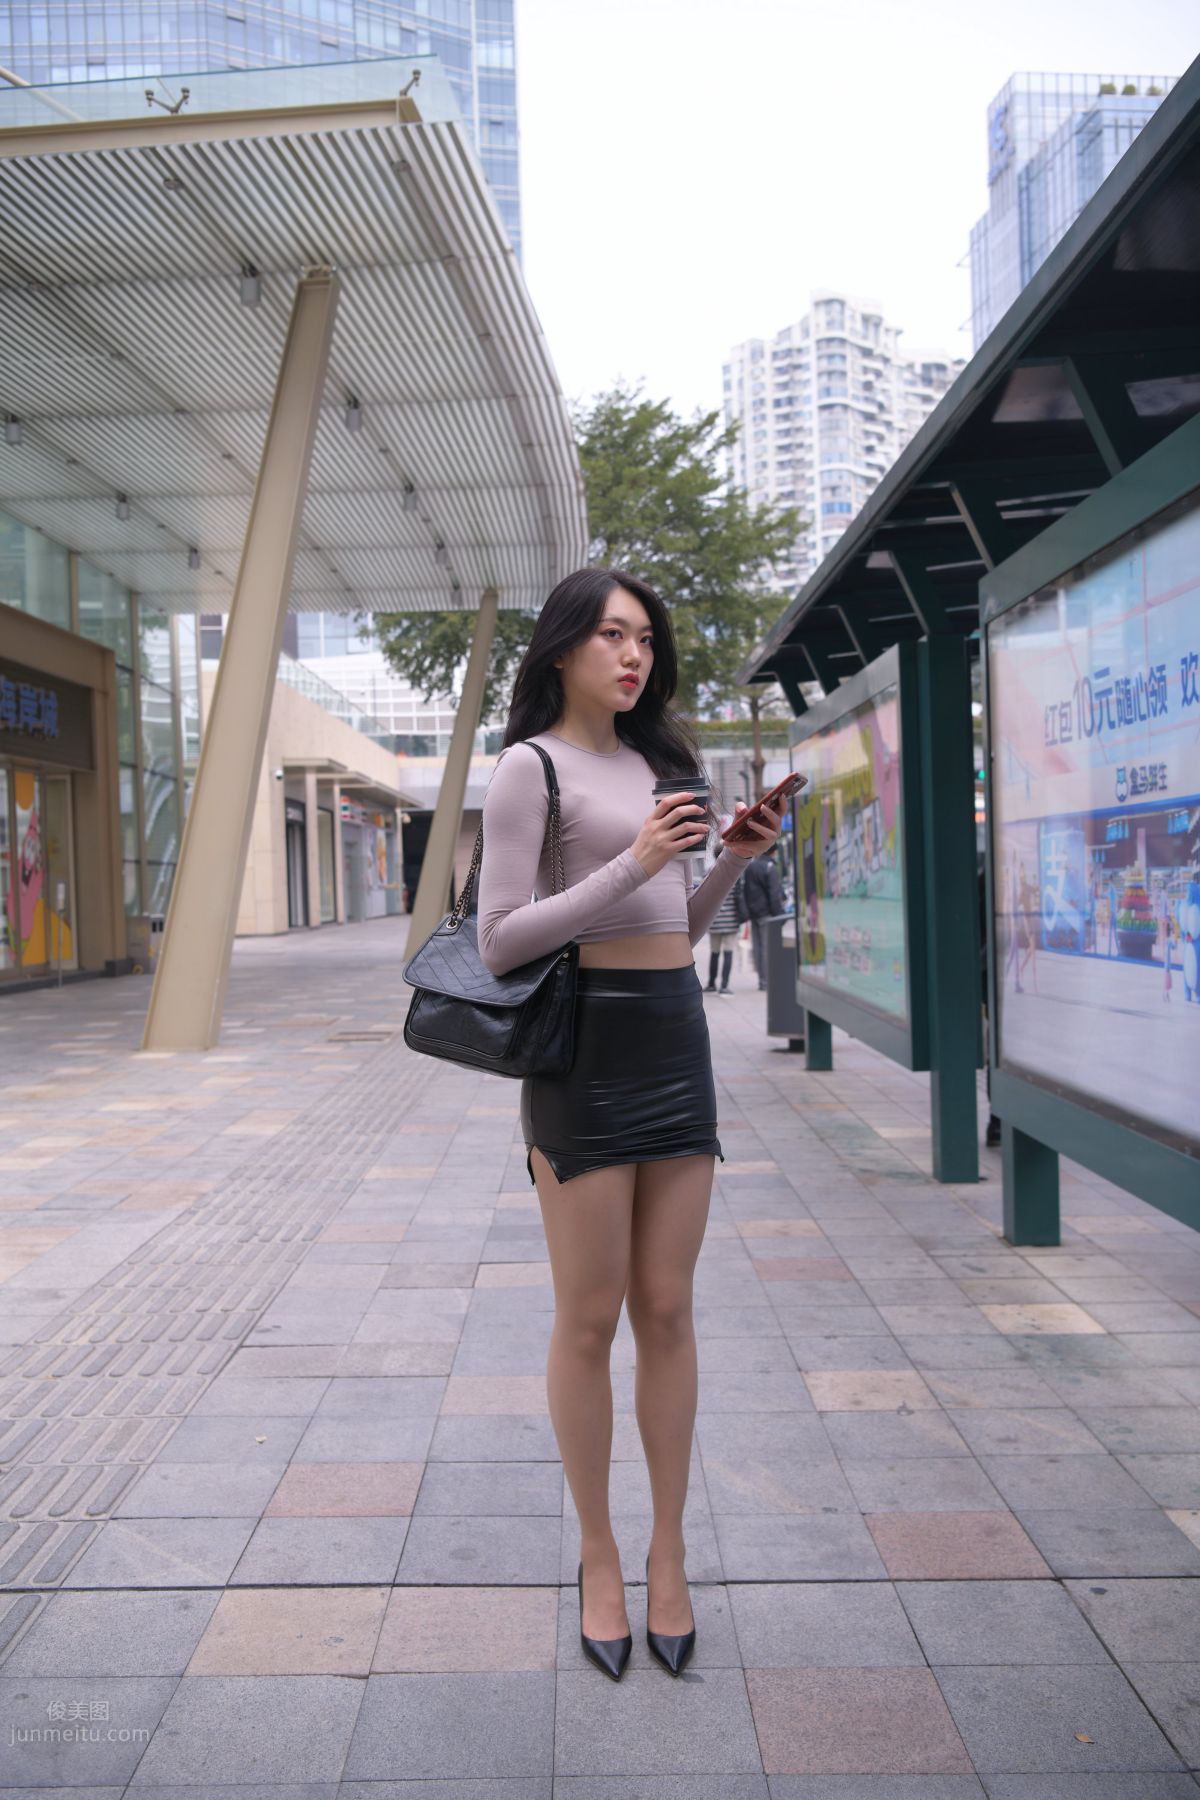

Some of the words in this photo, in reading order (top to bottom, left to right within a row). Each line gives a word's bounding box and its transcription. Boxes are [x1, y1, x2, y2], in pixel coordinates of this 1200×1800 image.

[1044, 664, 1168, 747] 红包10元随心领
